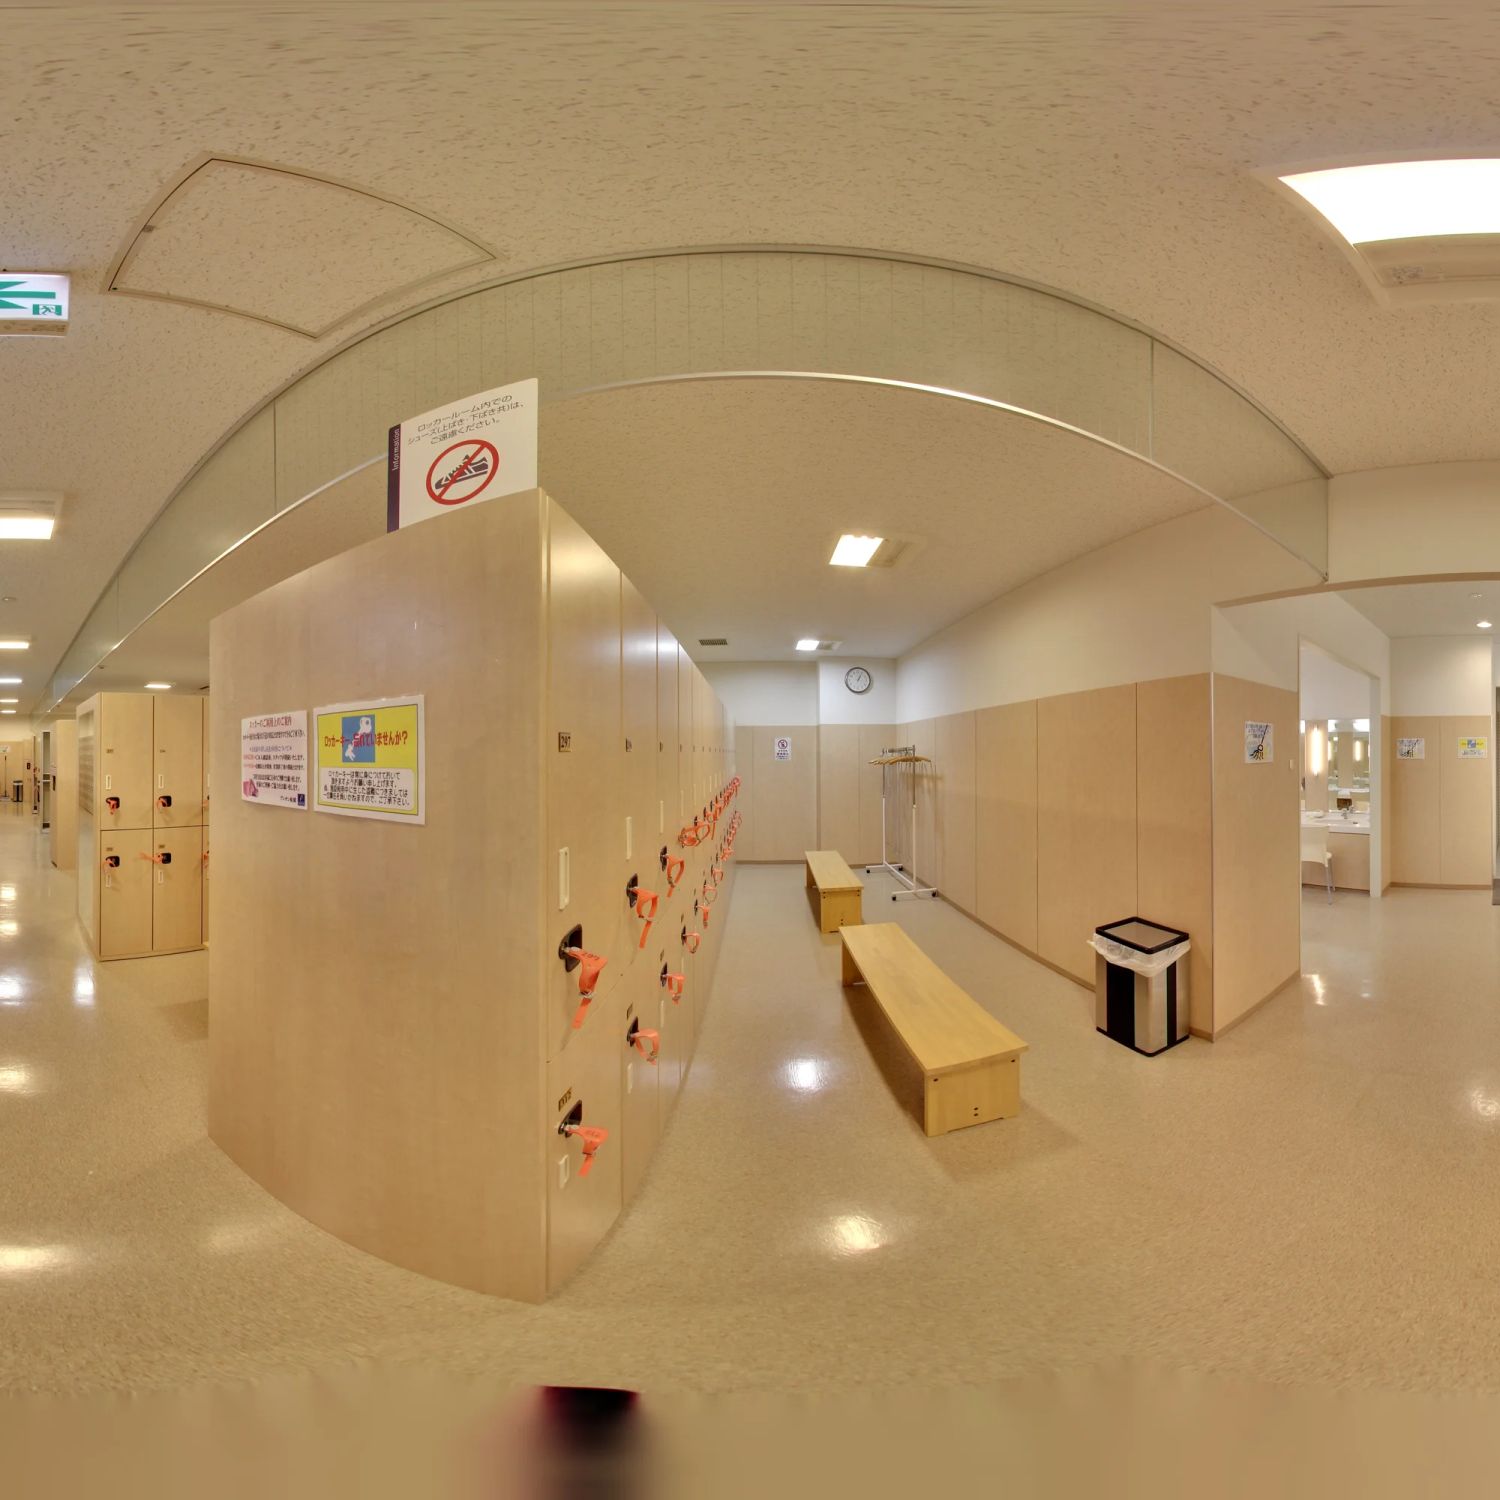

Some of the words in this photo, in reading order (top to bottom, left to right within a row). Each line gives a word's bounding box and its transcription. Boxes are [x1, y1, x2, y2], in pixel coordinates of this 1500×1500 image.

[417, 394, 513, 433] ロッカールーム内での
